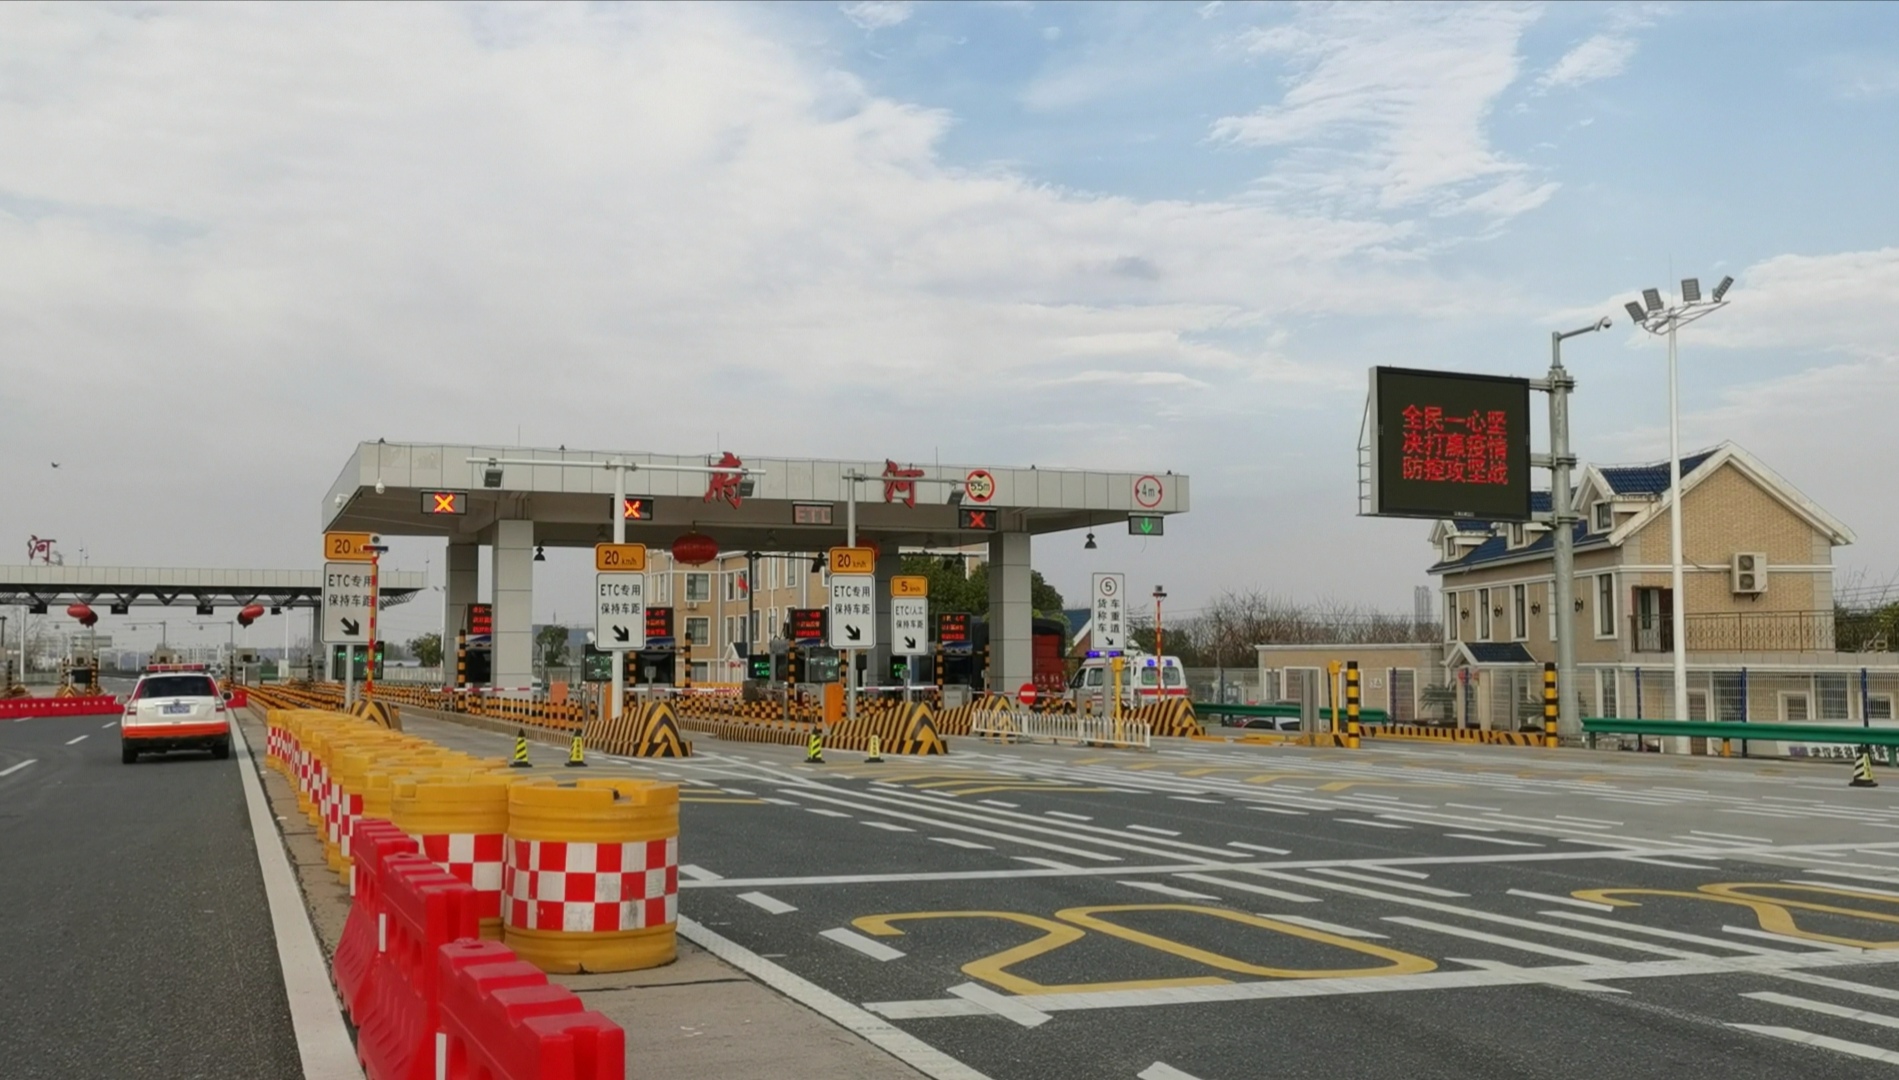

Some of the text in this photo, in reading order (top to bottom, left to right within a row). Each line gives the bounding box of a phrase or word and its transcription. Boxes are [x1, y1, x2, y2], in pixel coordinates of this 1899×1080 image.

[1402, 404, 1507, 435] 全民一心坚
[1402, 431, 1508, 461] 决打赢疫情
[1402, 455, 1509, 485] 防控攻坚战
[334, 539, 351, 554] 20
[604, 550, 620, 565] 20
[837, 553, 851, 568] 20
[600, 584, 641, 596] ETC专用
[834, 585, 871, 597] ETC专用
[901, 581, 908, 592] 5
[1104, 581, 1112, 592] 5
[601, 602, 641, 615] 保持车距
[834, 603, 871, 615] 保持车距
[896, 620, 924, 630] 保持车距
[851, 904, 1438, 996] 20
